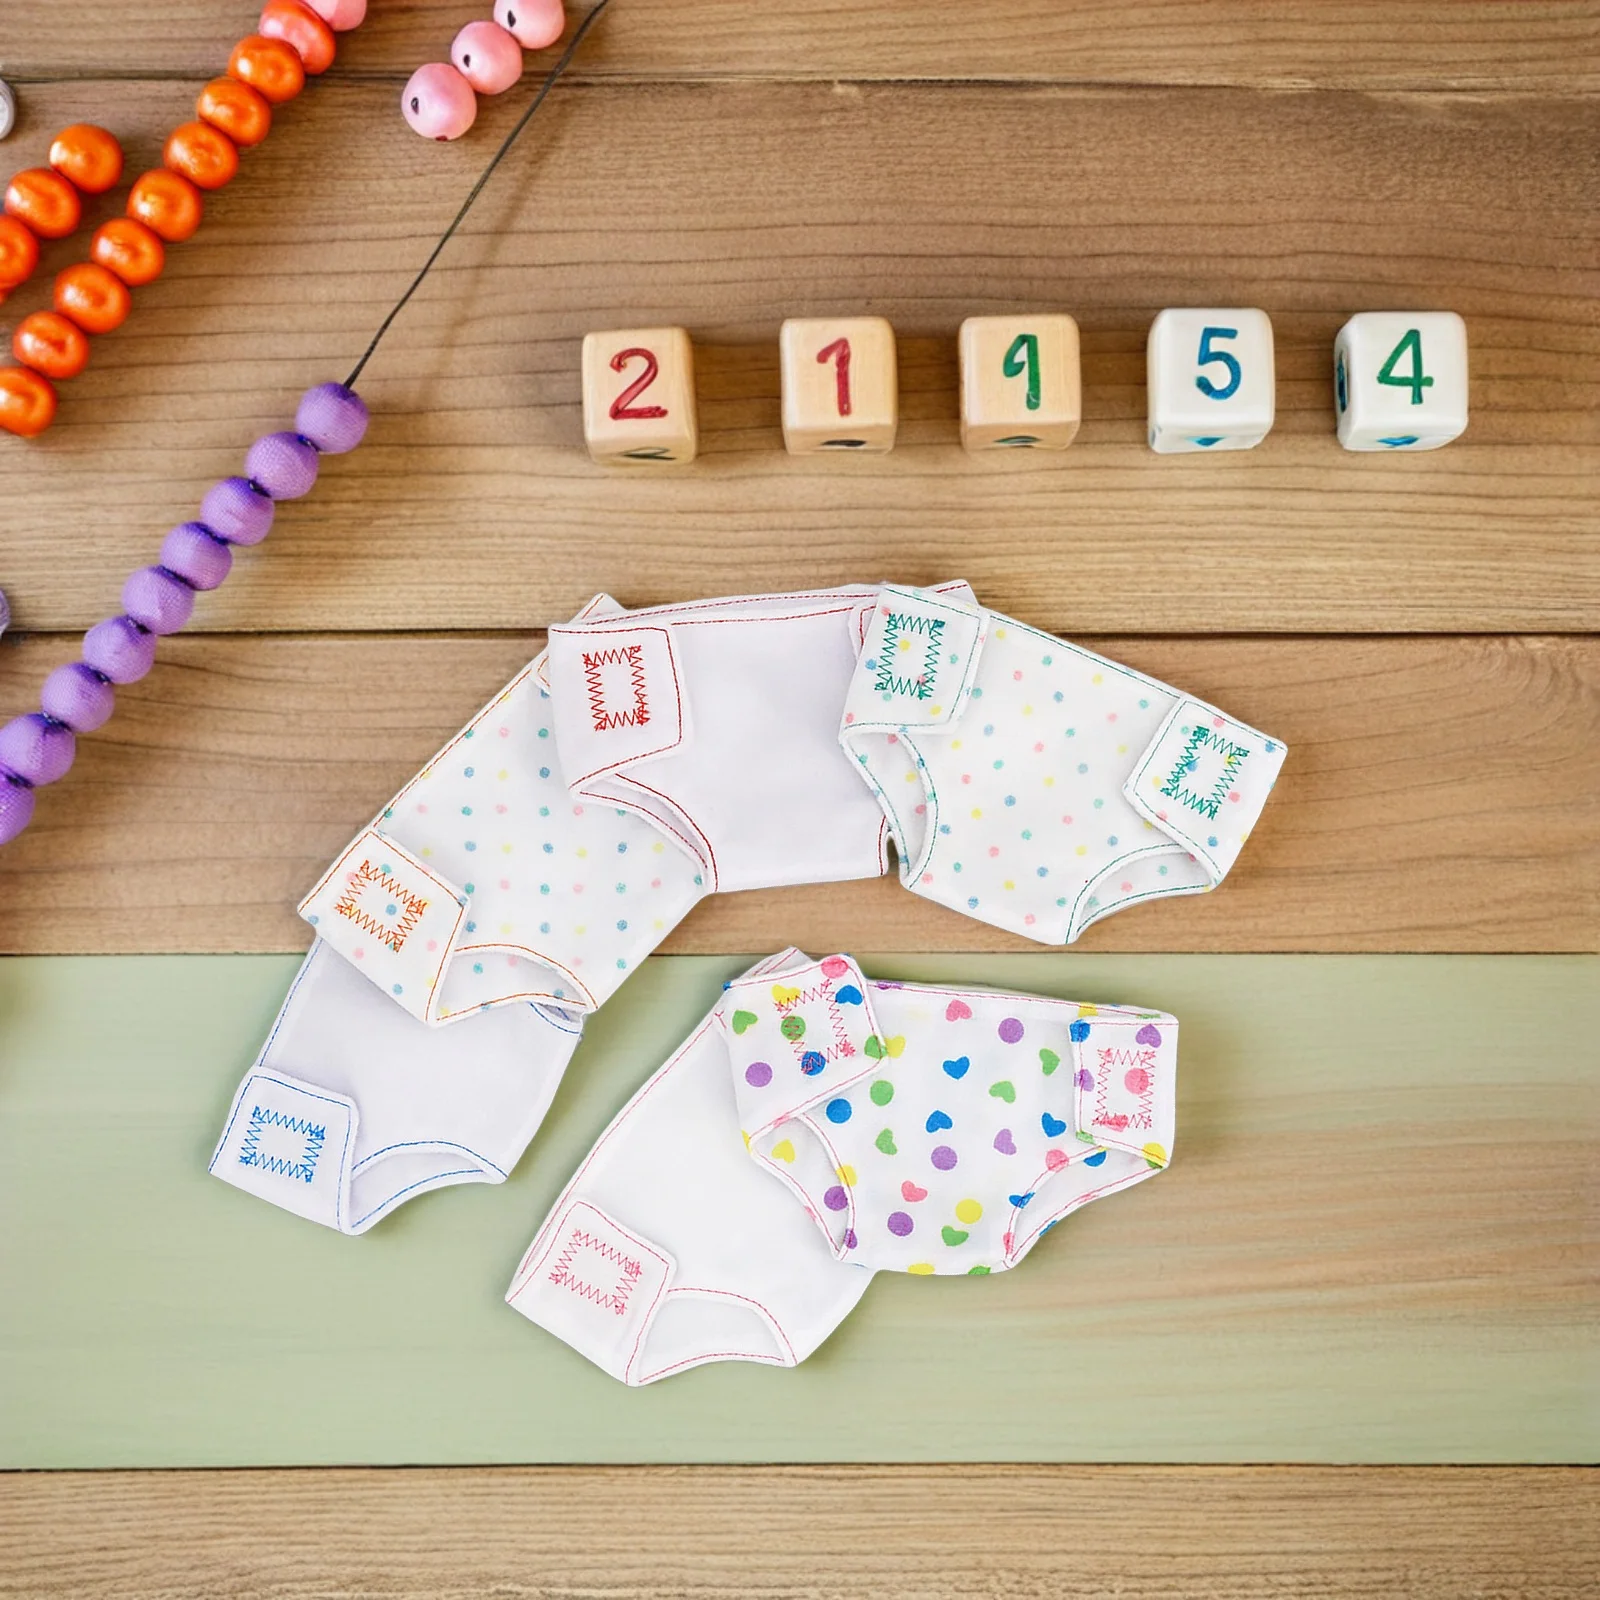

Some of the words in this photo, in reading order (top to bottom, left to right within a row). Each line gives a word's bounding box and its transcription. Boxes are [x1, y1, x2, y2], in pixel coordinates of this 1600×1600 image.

[609, 347, 669, 421] 2
[816, 337, 852, 418] 1
[1195, 326, 1242, 401] 5
[1376, 328, 1434, 405] 4
